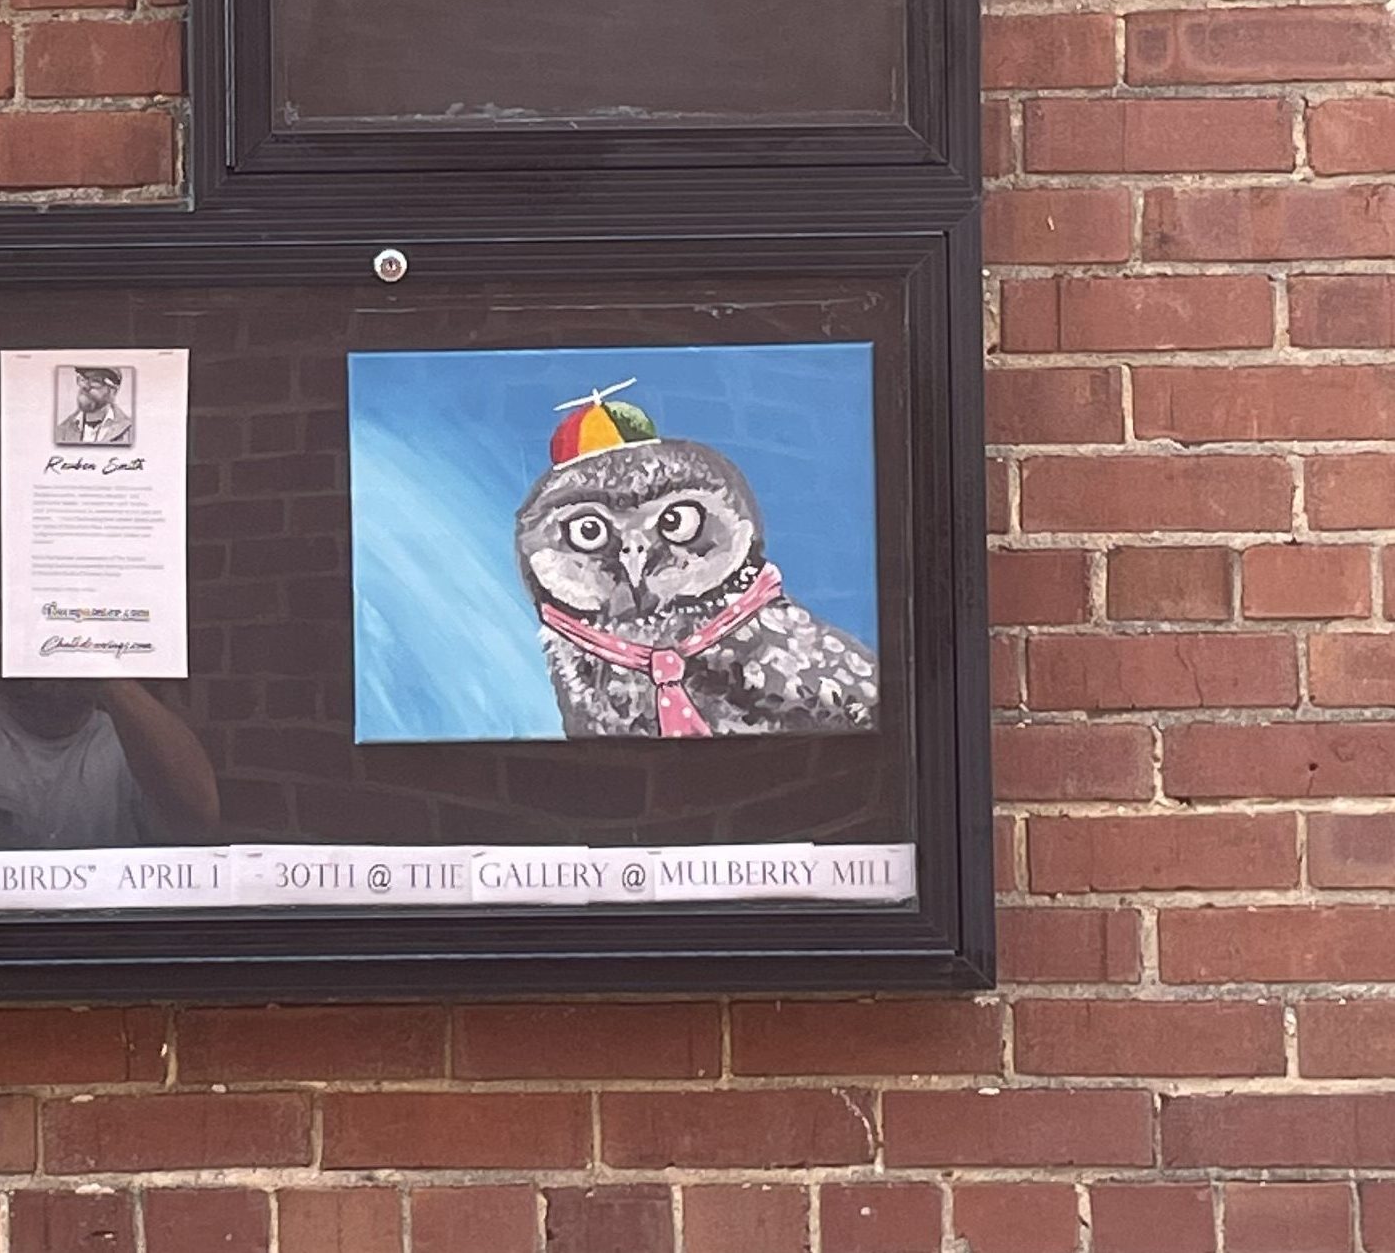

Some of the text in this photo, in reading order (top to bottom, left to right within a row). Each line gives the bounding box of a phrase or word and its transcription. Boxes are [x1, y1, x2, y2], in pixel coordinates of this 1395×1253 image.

[101, 457, 147, 475] Smith
[117, 863, 202, 890] APRIL
[211, 863, 221, 890] 1
[274, 862, 356, 889] 30TH
[367, 862, 393, 892] @
[404, 862, 465, 889] THE
[477, 861, 611, 889] GALLERY
[620, 862, 647, 892] @
[659, 859, 819, 887] MULBERRY
[831, 859, 897, 886] MILL
